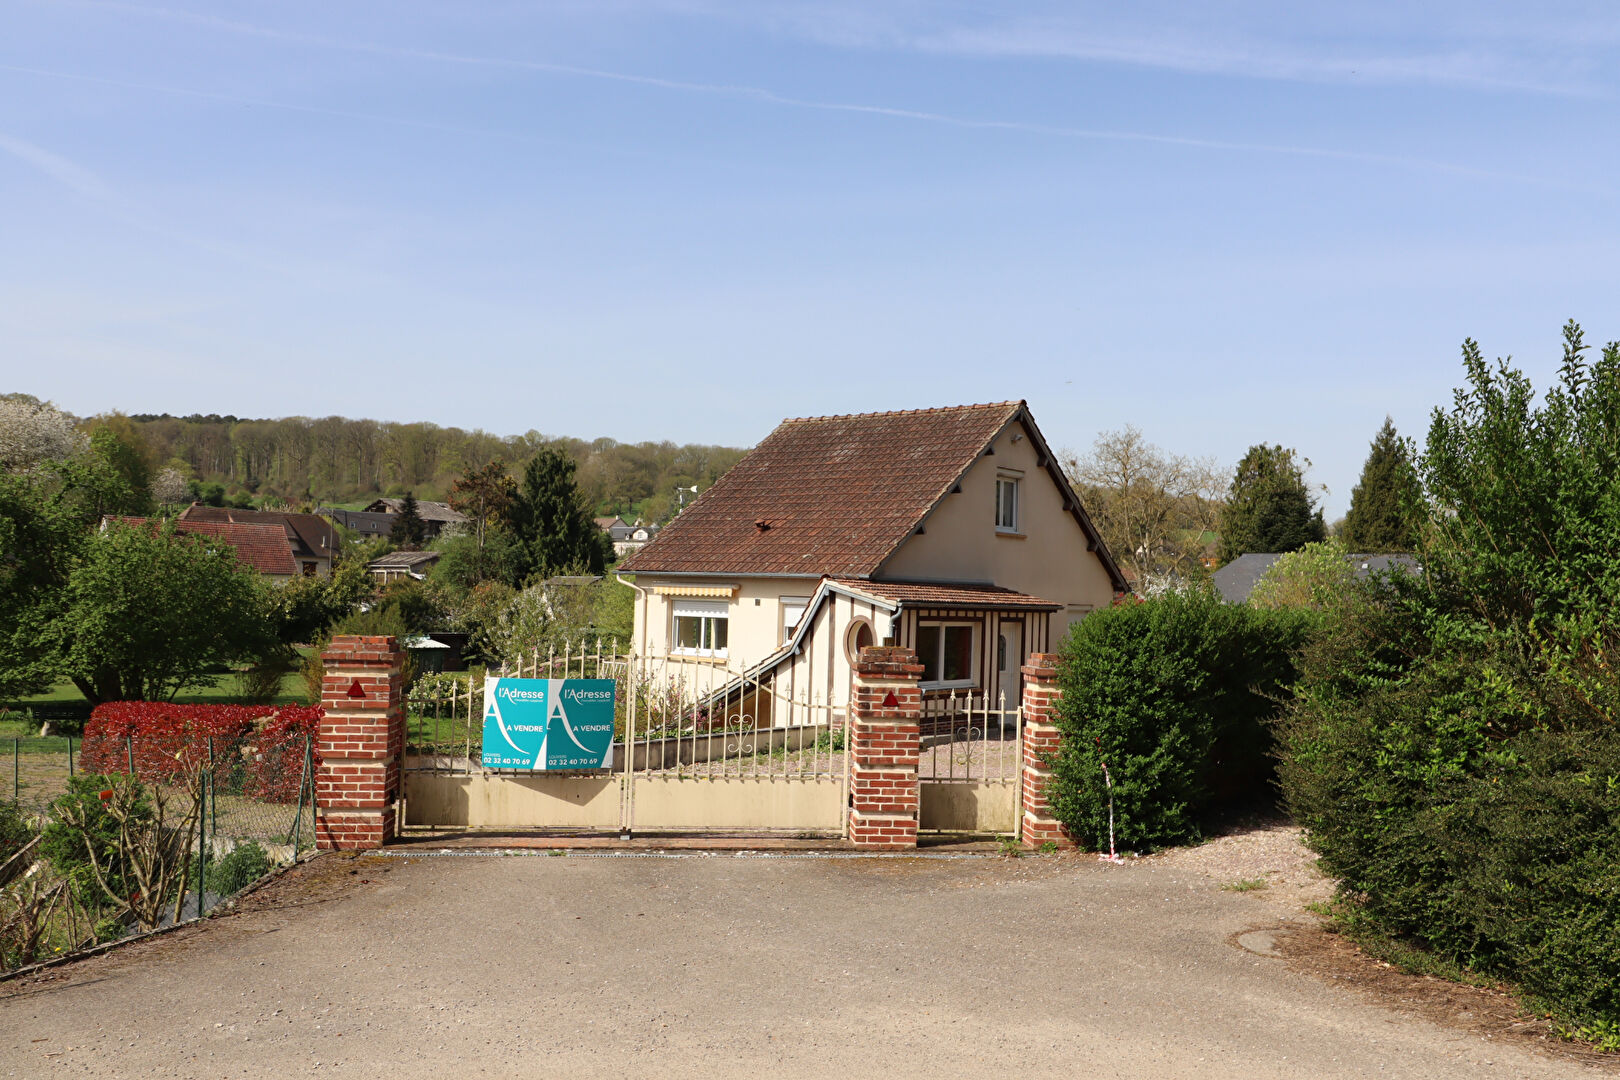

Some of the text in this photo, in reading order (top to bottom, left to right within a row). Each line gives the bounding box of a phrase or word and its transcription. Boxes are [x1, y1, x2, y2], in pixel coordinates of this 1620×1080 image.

[499, 687, 544, 704] l'Adresse
[565, 689, 611, 705] l'Adresse
[506, 724, 544, 732] A VENDRE
[580, 724, 611, 732] VENDRE
[521, 758, 531, 766] 69
